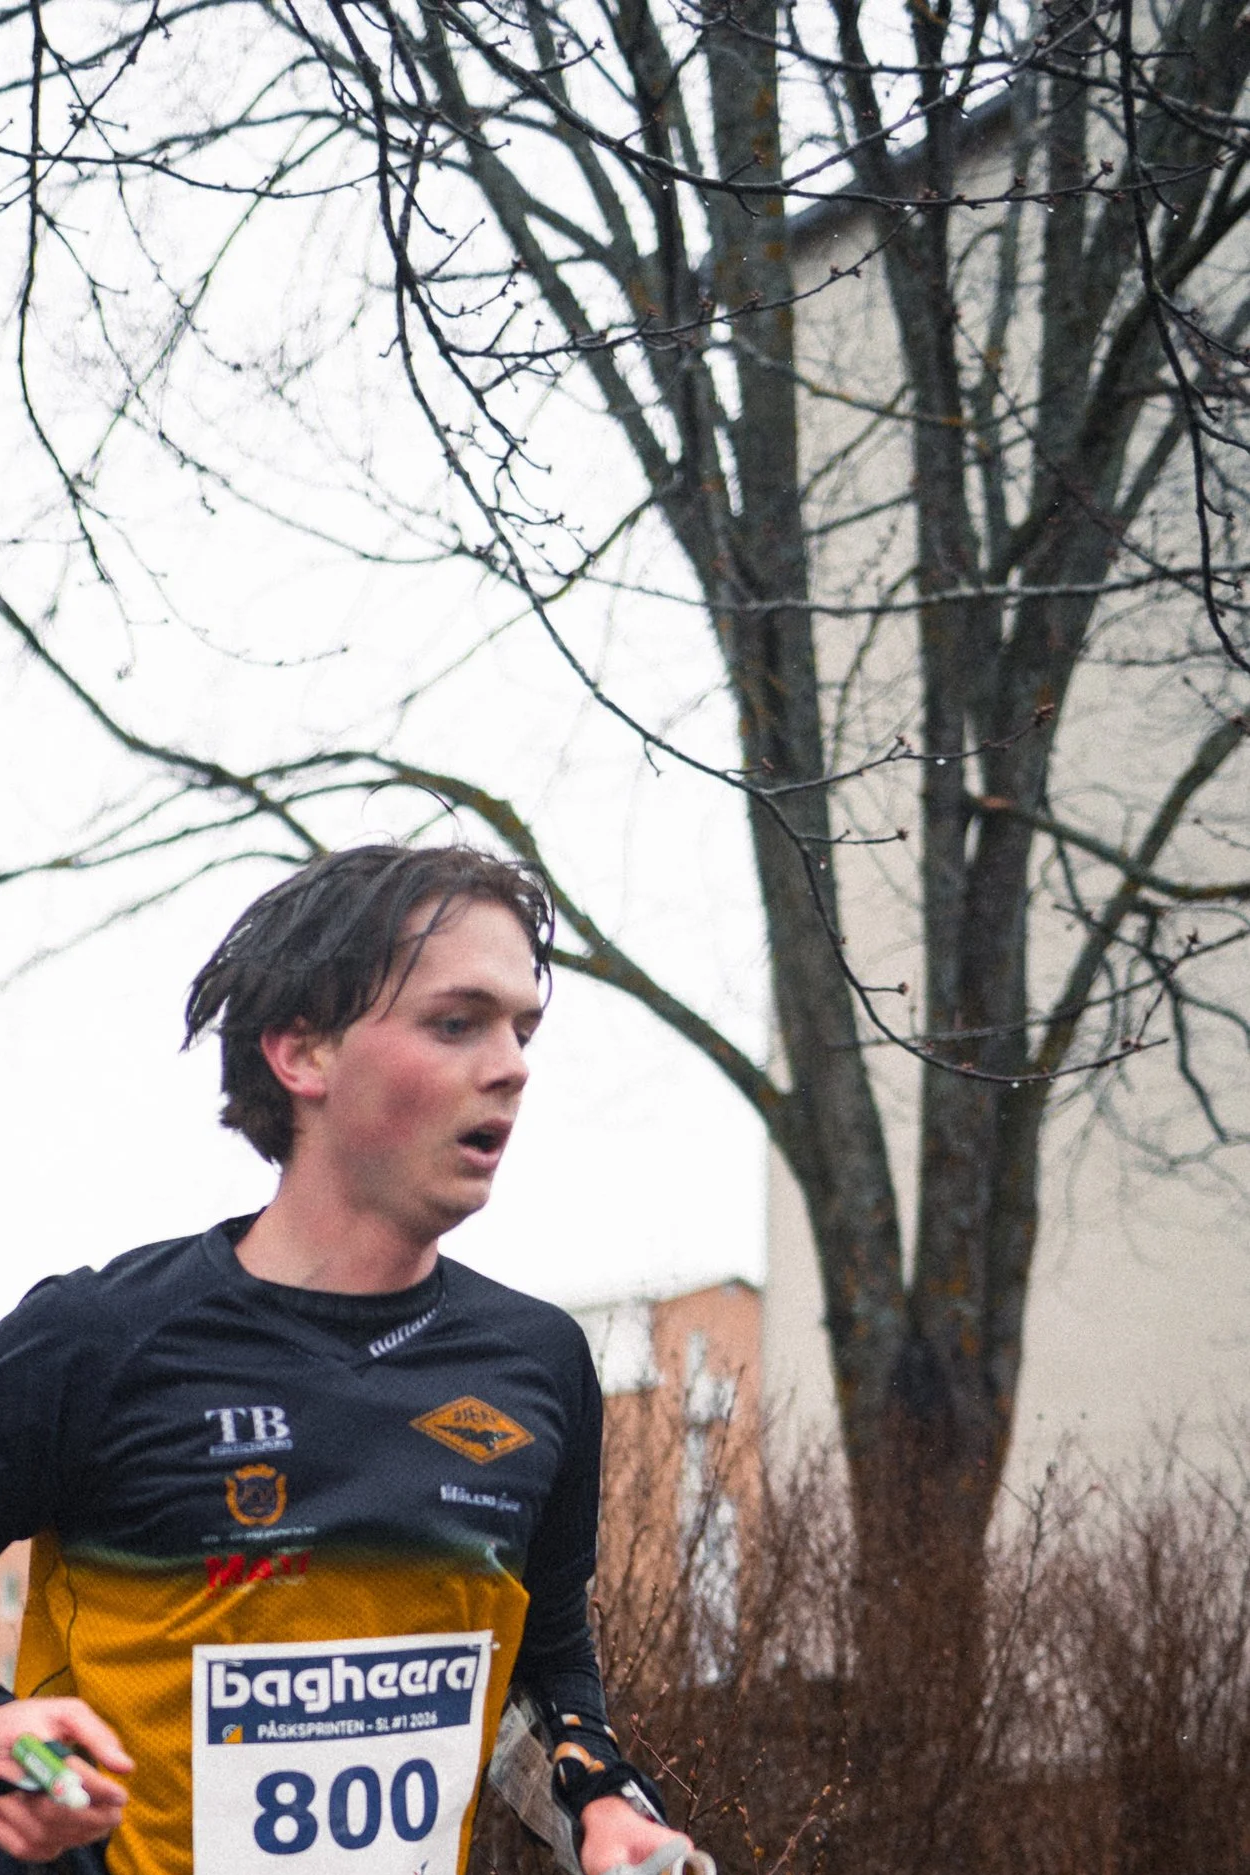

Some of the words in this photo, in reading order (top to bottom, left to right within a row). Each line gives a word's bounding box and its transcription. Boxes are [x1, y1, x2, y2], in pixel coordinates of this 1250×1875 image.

[204, 1405, 290, 1443] TB
[210, 1655, 478, 1713] bagheera
[257, 1719, 365, 1740] PÅSKSPRINTEN
[253, 1758, 439, 1855] 800
